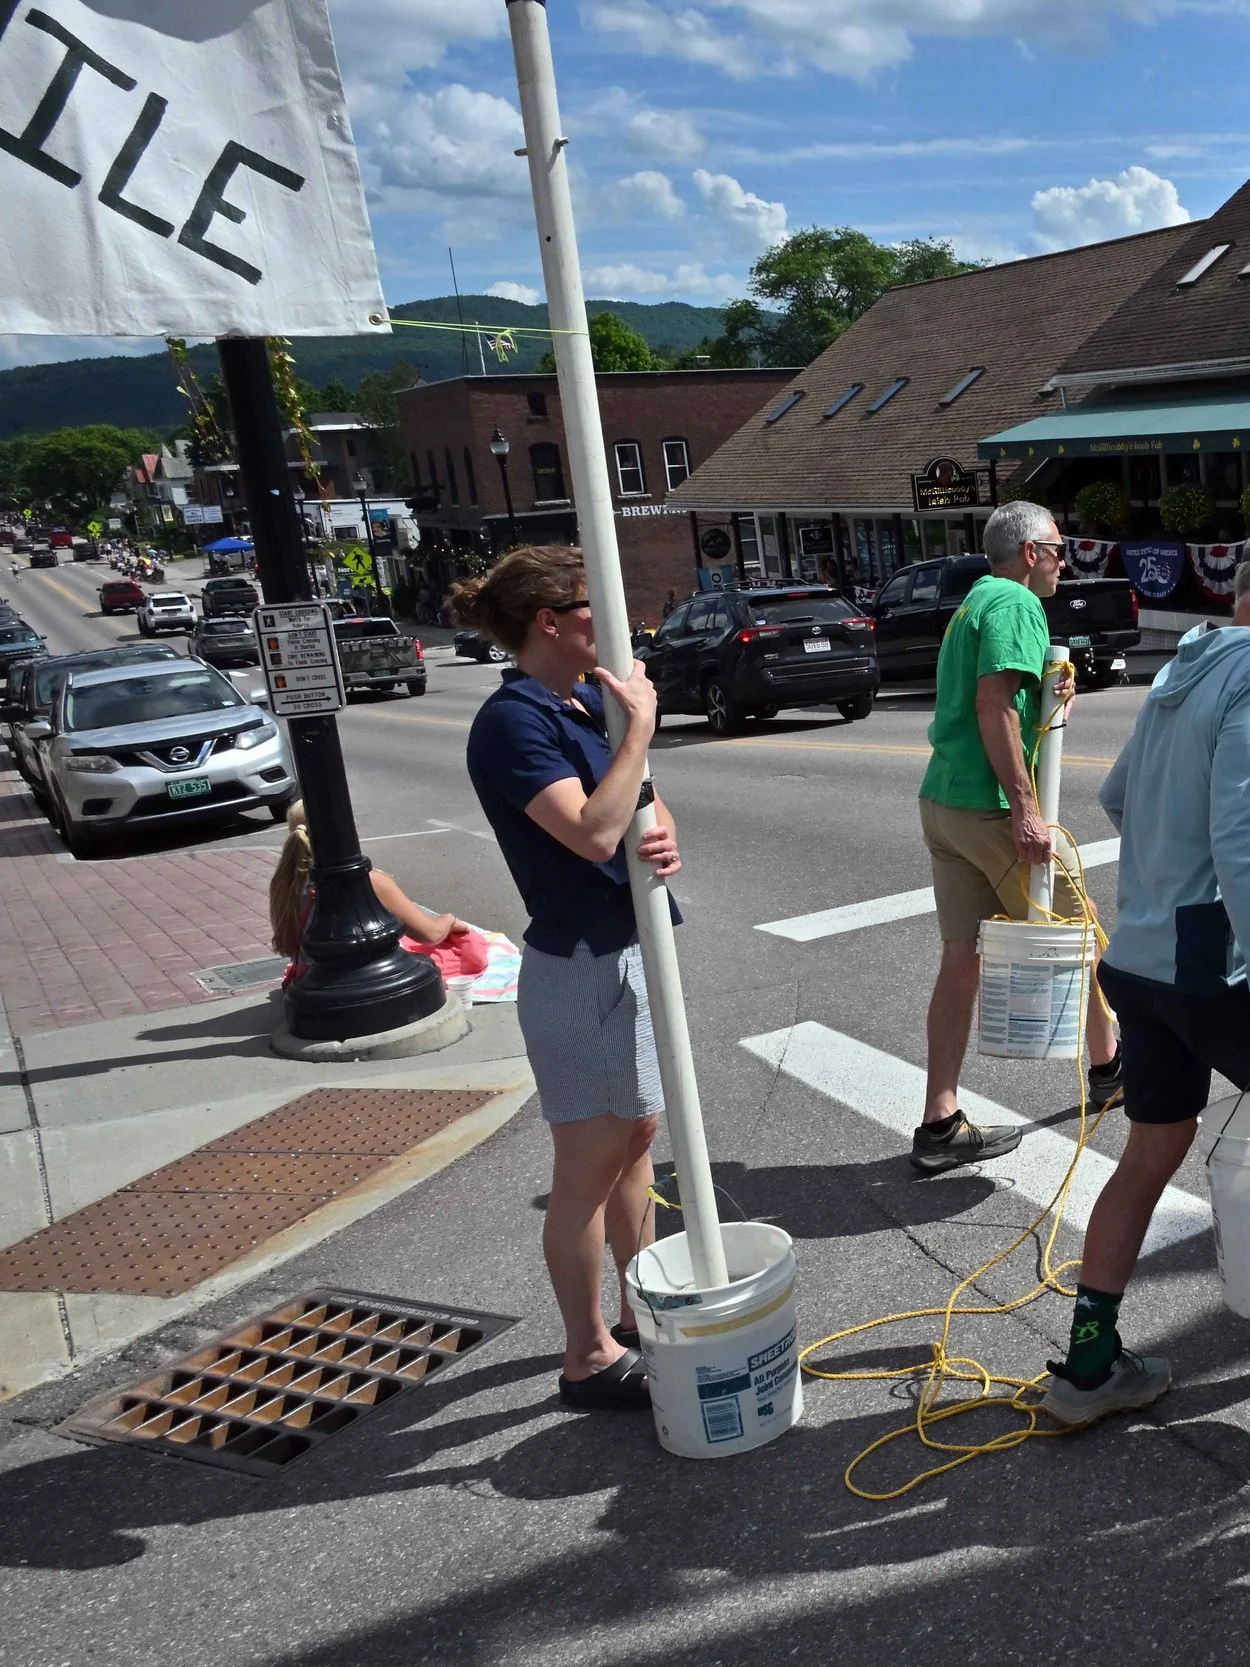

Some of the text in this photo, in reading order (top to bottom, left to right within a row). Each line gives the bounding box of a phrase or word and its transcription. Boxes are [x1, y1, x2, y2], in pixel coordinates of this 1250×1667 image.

[0, 0, 306, 286] ILE
[621, 504, 688, 518] BREW
[754, 1375, 765, 1386] All
[756, 1380, 774, 1396] Joint
[757, 1401, 774, 1417] USG
